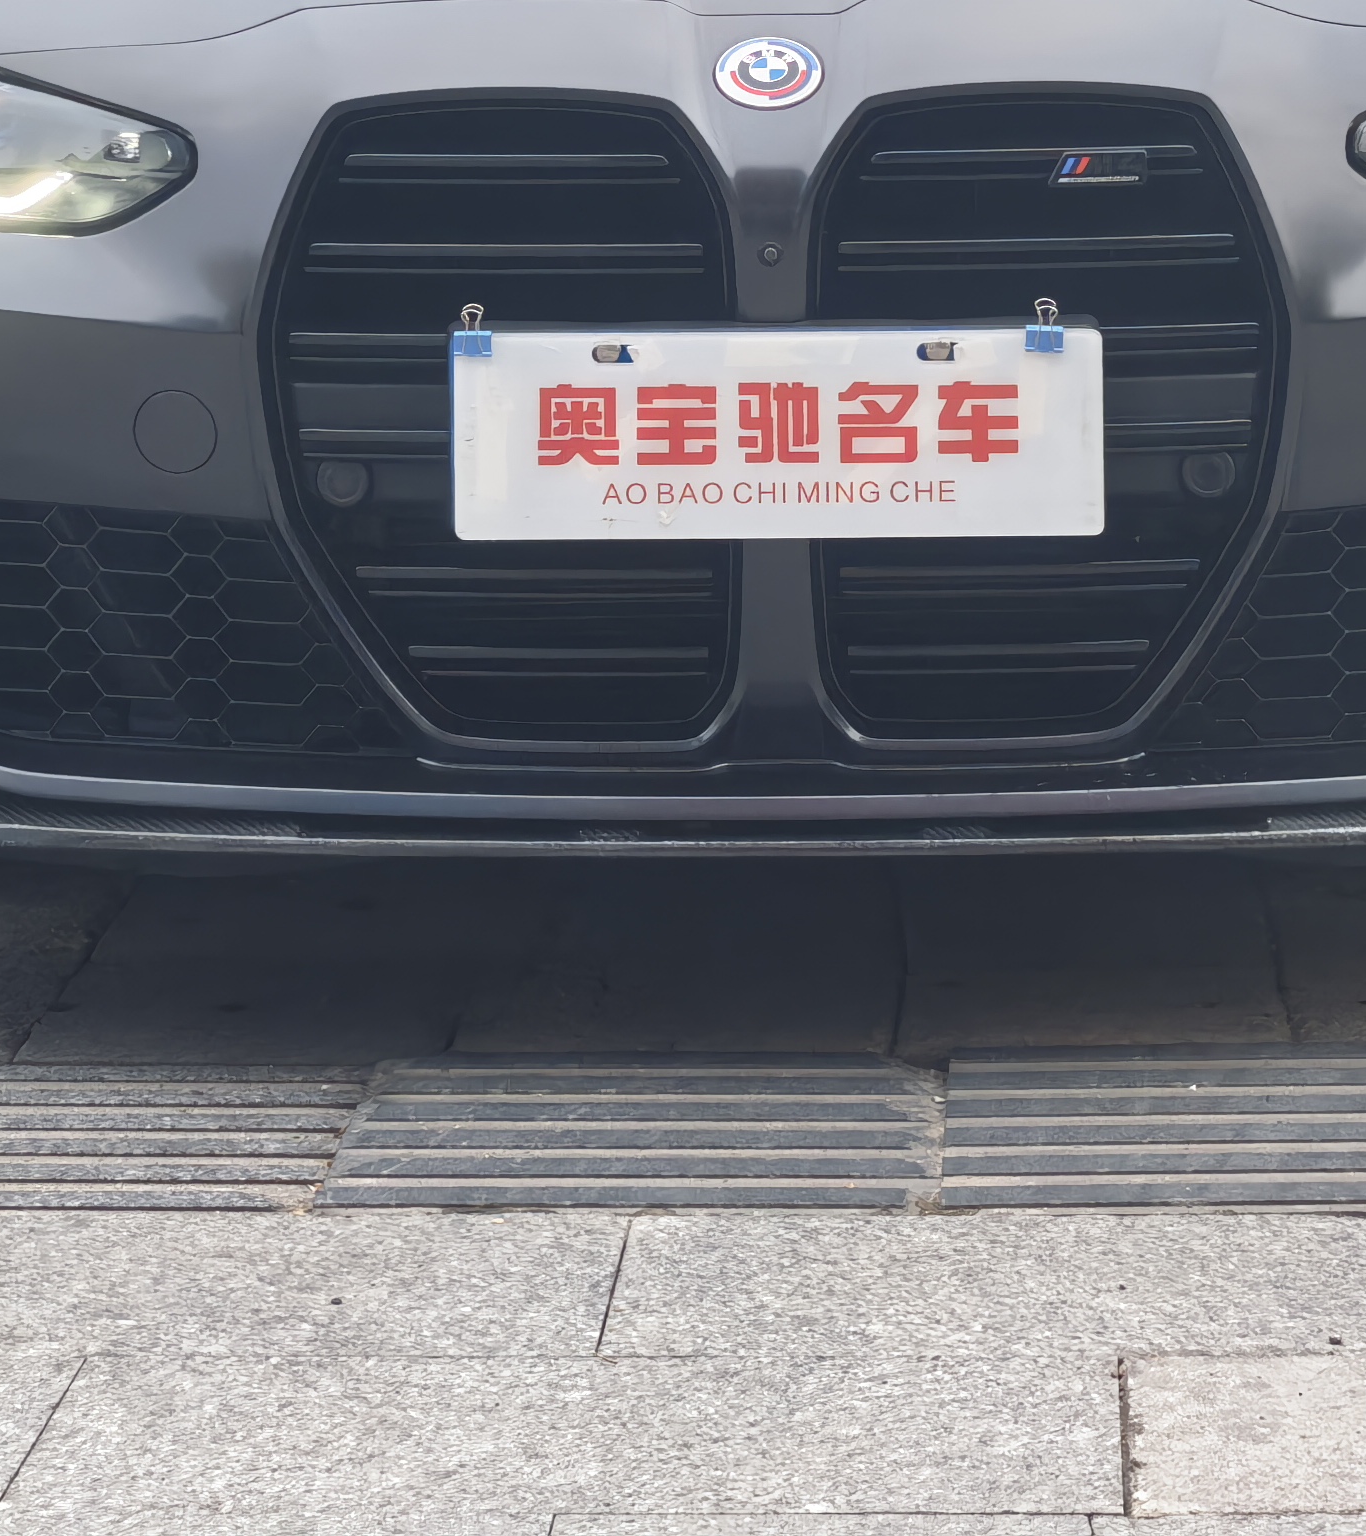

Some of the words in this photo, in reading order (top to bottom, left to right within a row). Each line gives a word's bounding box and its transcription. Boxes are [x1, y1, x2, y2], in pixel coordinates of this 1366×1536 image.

[742, 49, 796, 65] BMW
[537, 381, 1020, 467] 奥宝驰名车
[602, 482, 649, 505] AO
[657, 482, 724, 505] BAO
[734, 481, 787, 504] CHI
[798, 481, 882, 504] MING
[890, 480, 956, 503] CHE
